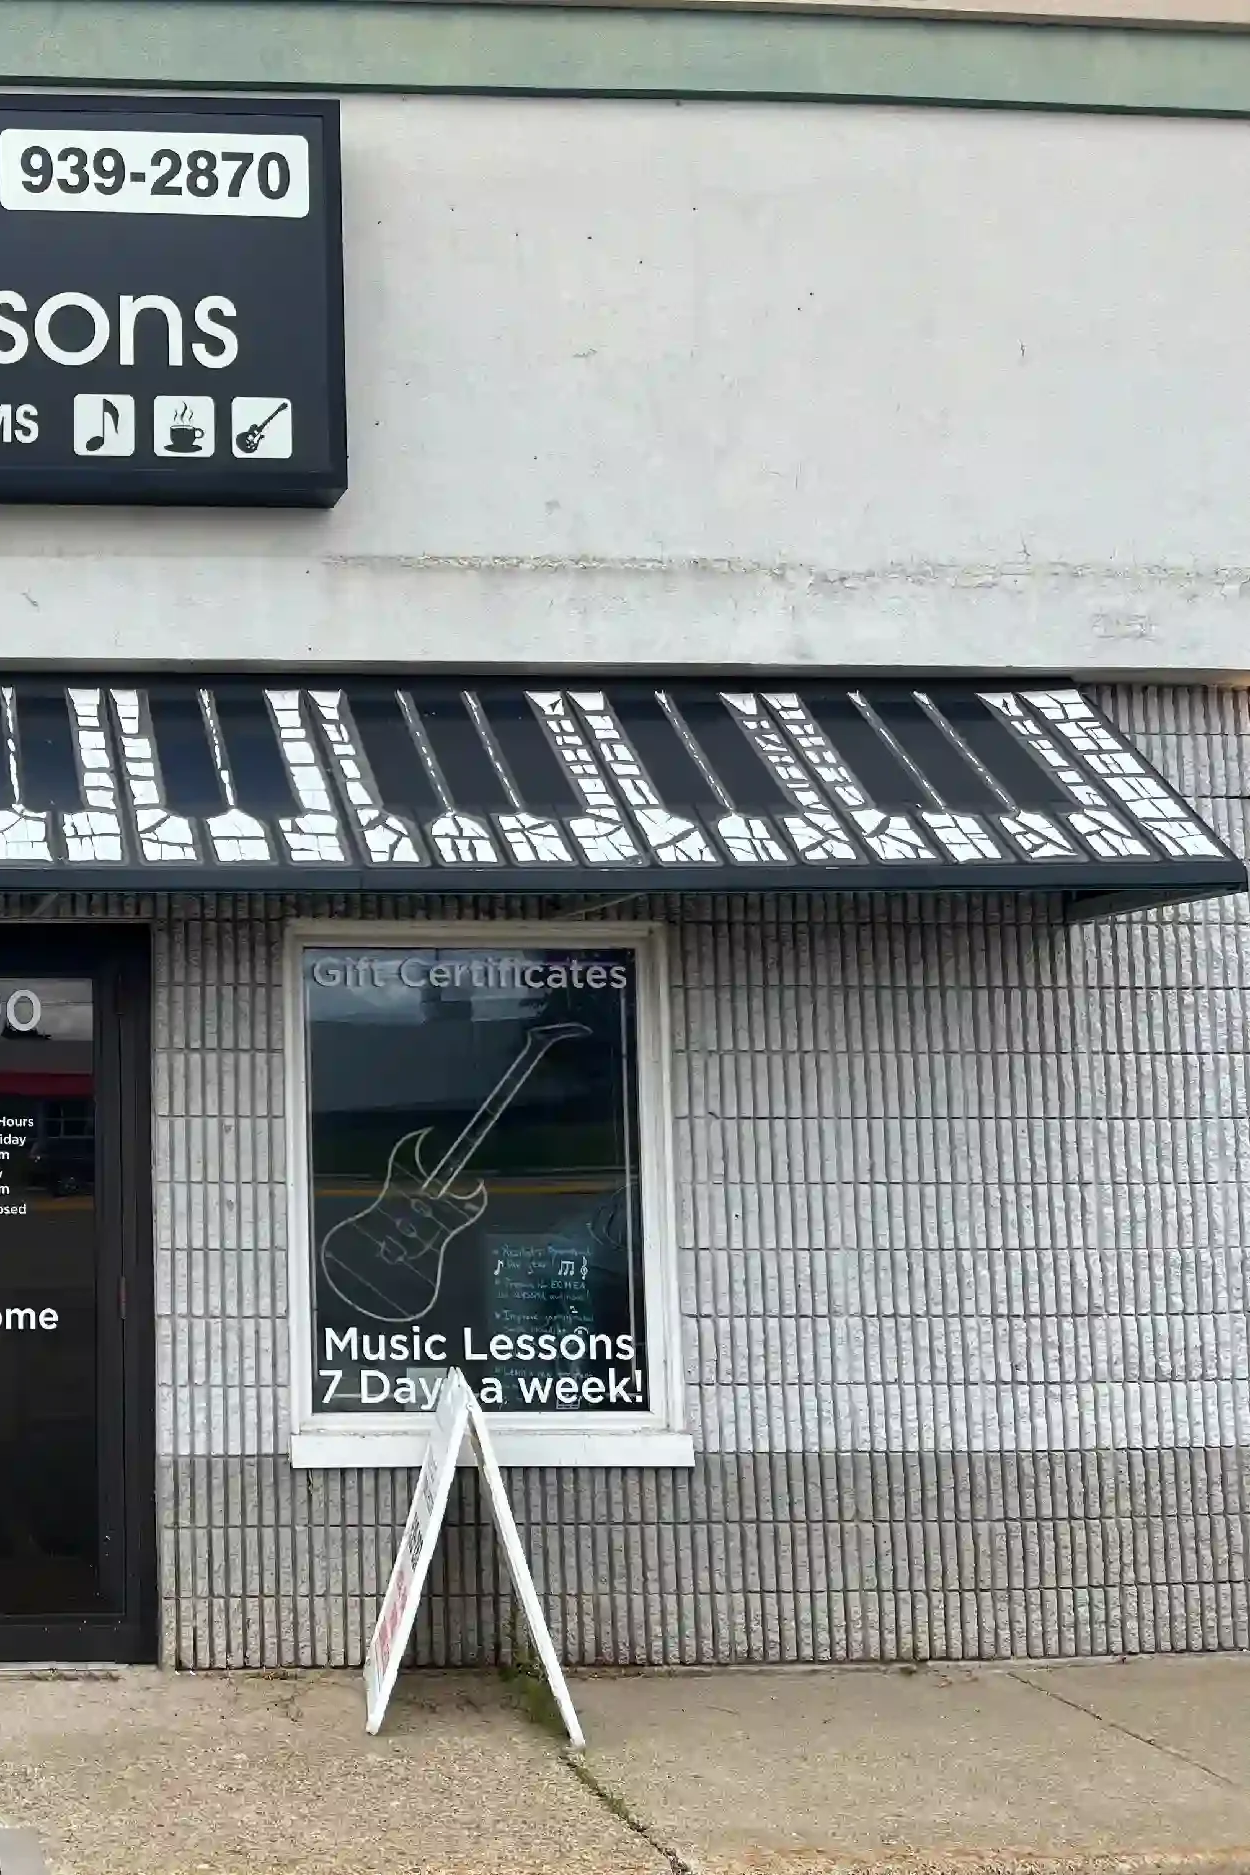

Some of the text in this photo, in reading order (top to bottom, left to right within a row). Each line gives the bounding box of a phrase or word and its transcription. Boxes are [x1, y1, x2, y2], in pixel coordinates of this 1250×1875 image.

[19, 145, 290, 200] 939-2870
[313, 956, 628, 989] Gift Certificates
[324, 1325, 635, 1361] Music Lessons
[318, 1367, 643, 1411] 7 Day a week!
